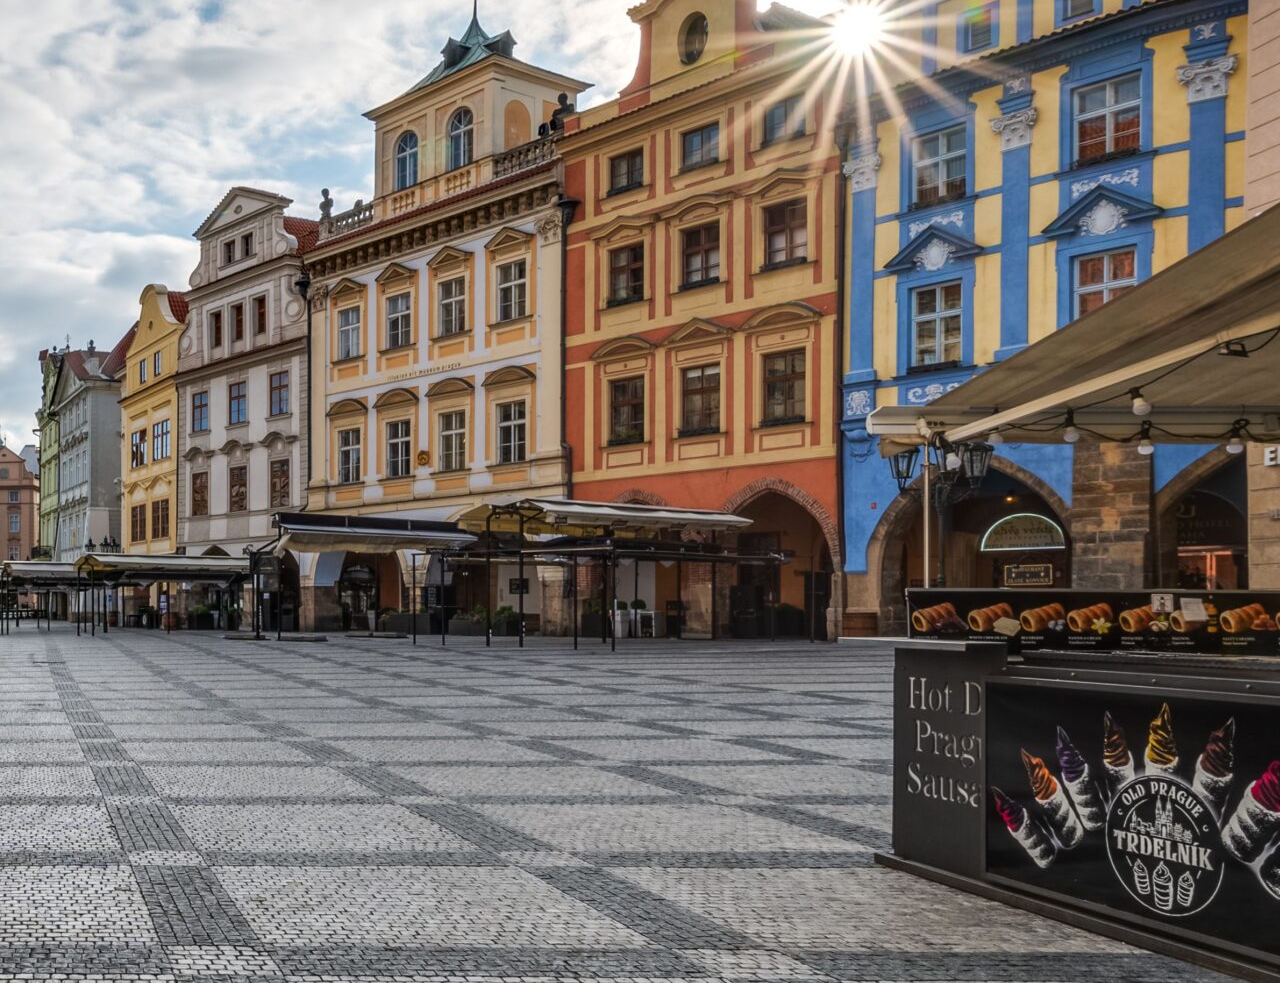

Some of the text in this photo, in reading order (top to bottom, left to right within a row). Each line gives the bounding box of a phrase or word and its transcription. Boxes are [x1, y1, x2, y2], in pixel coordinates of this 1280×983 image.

[1264, 446, 1280, 466] E
[908, 676, 952, 713] Hot
[1121, 781, 1204, 818] OLD PRAGUE
[1113, 828, 1215, 871] TRDELNÍK
